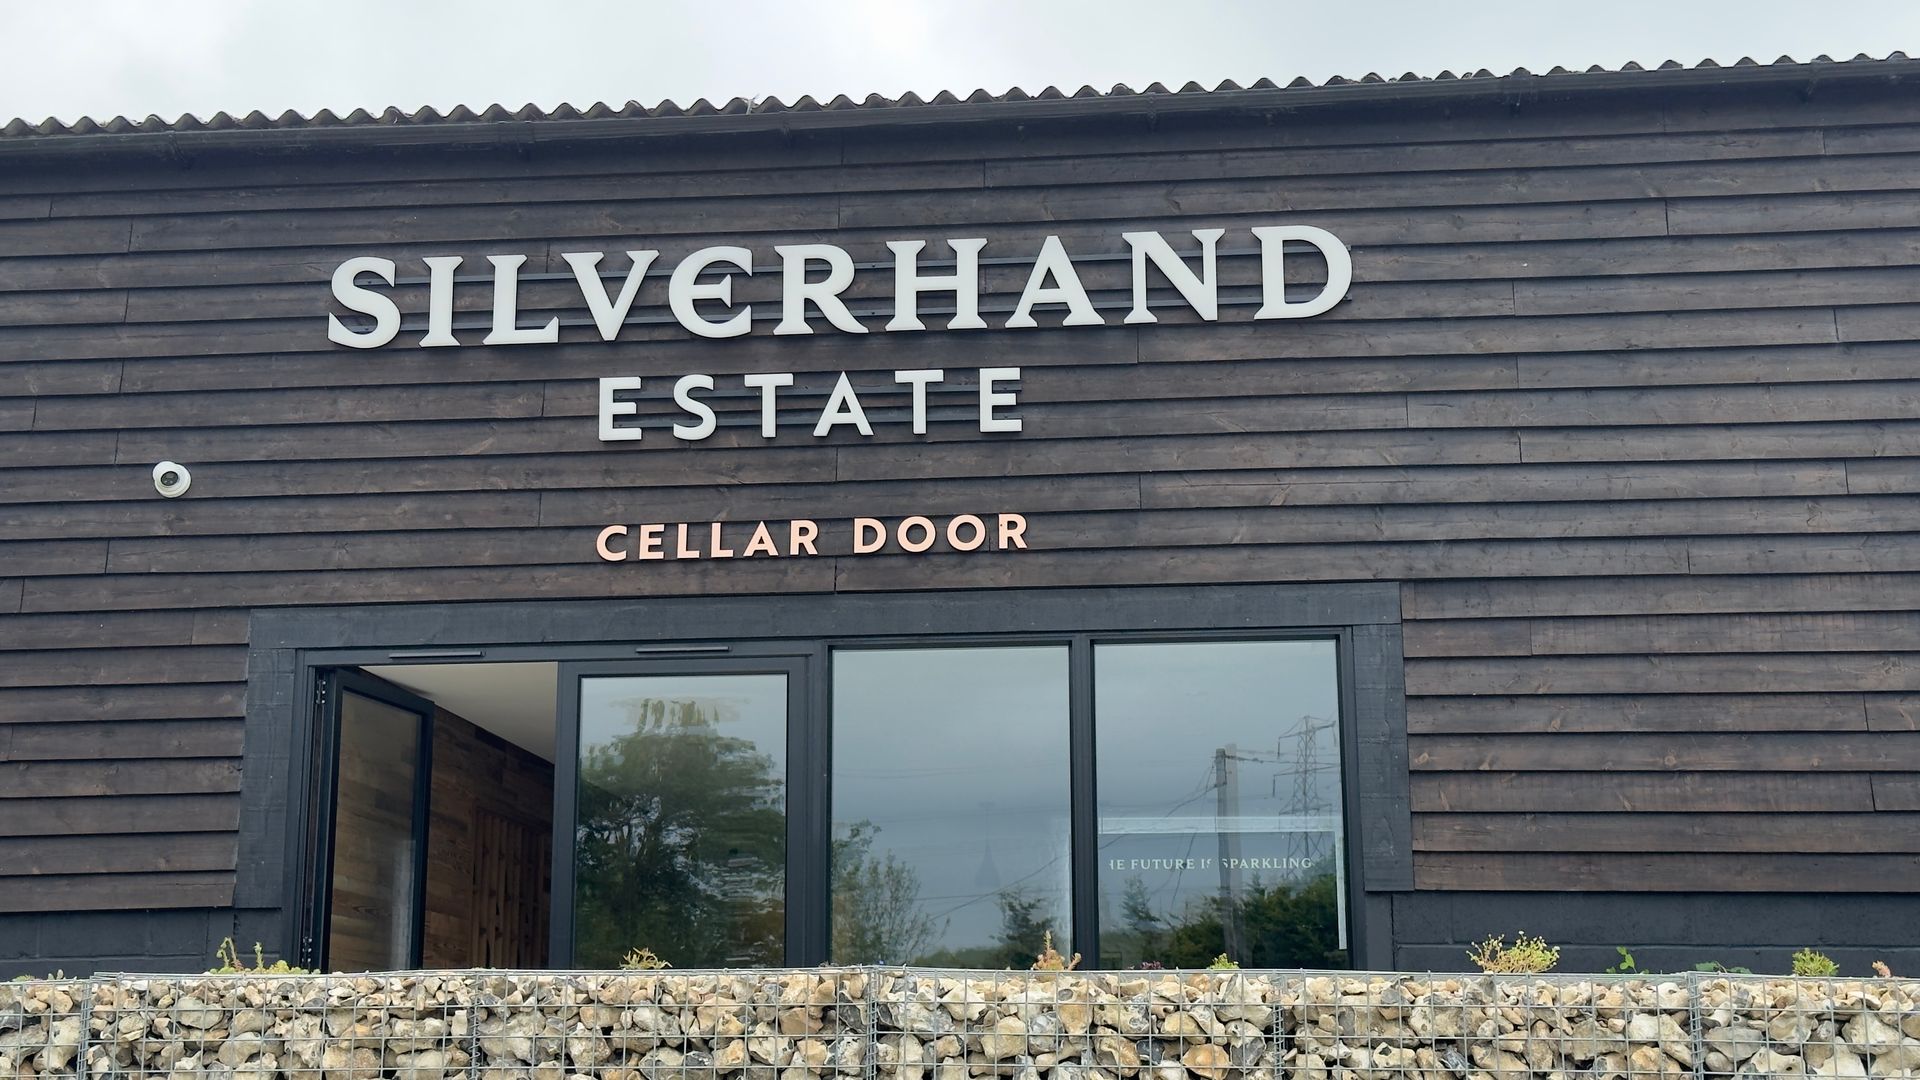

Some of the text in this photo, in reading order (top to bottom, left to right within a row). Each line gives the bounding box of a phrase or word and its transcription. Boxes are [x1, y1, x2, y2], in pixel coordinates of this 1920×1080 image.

[328, 225, 1352, 349] SILVERHAND
[598, 367, 1022, 441] ESTATE
[596, 513, 1028, 562] CELLAR DOOR
[1131, 858, 1196, 870] FUTURE
